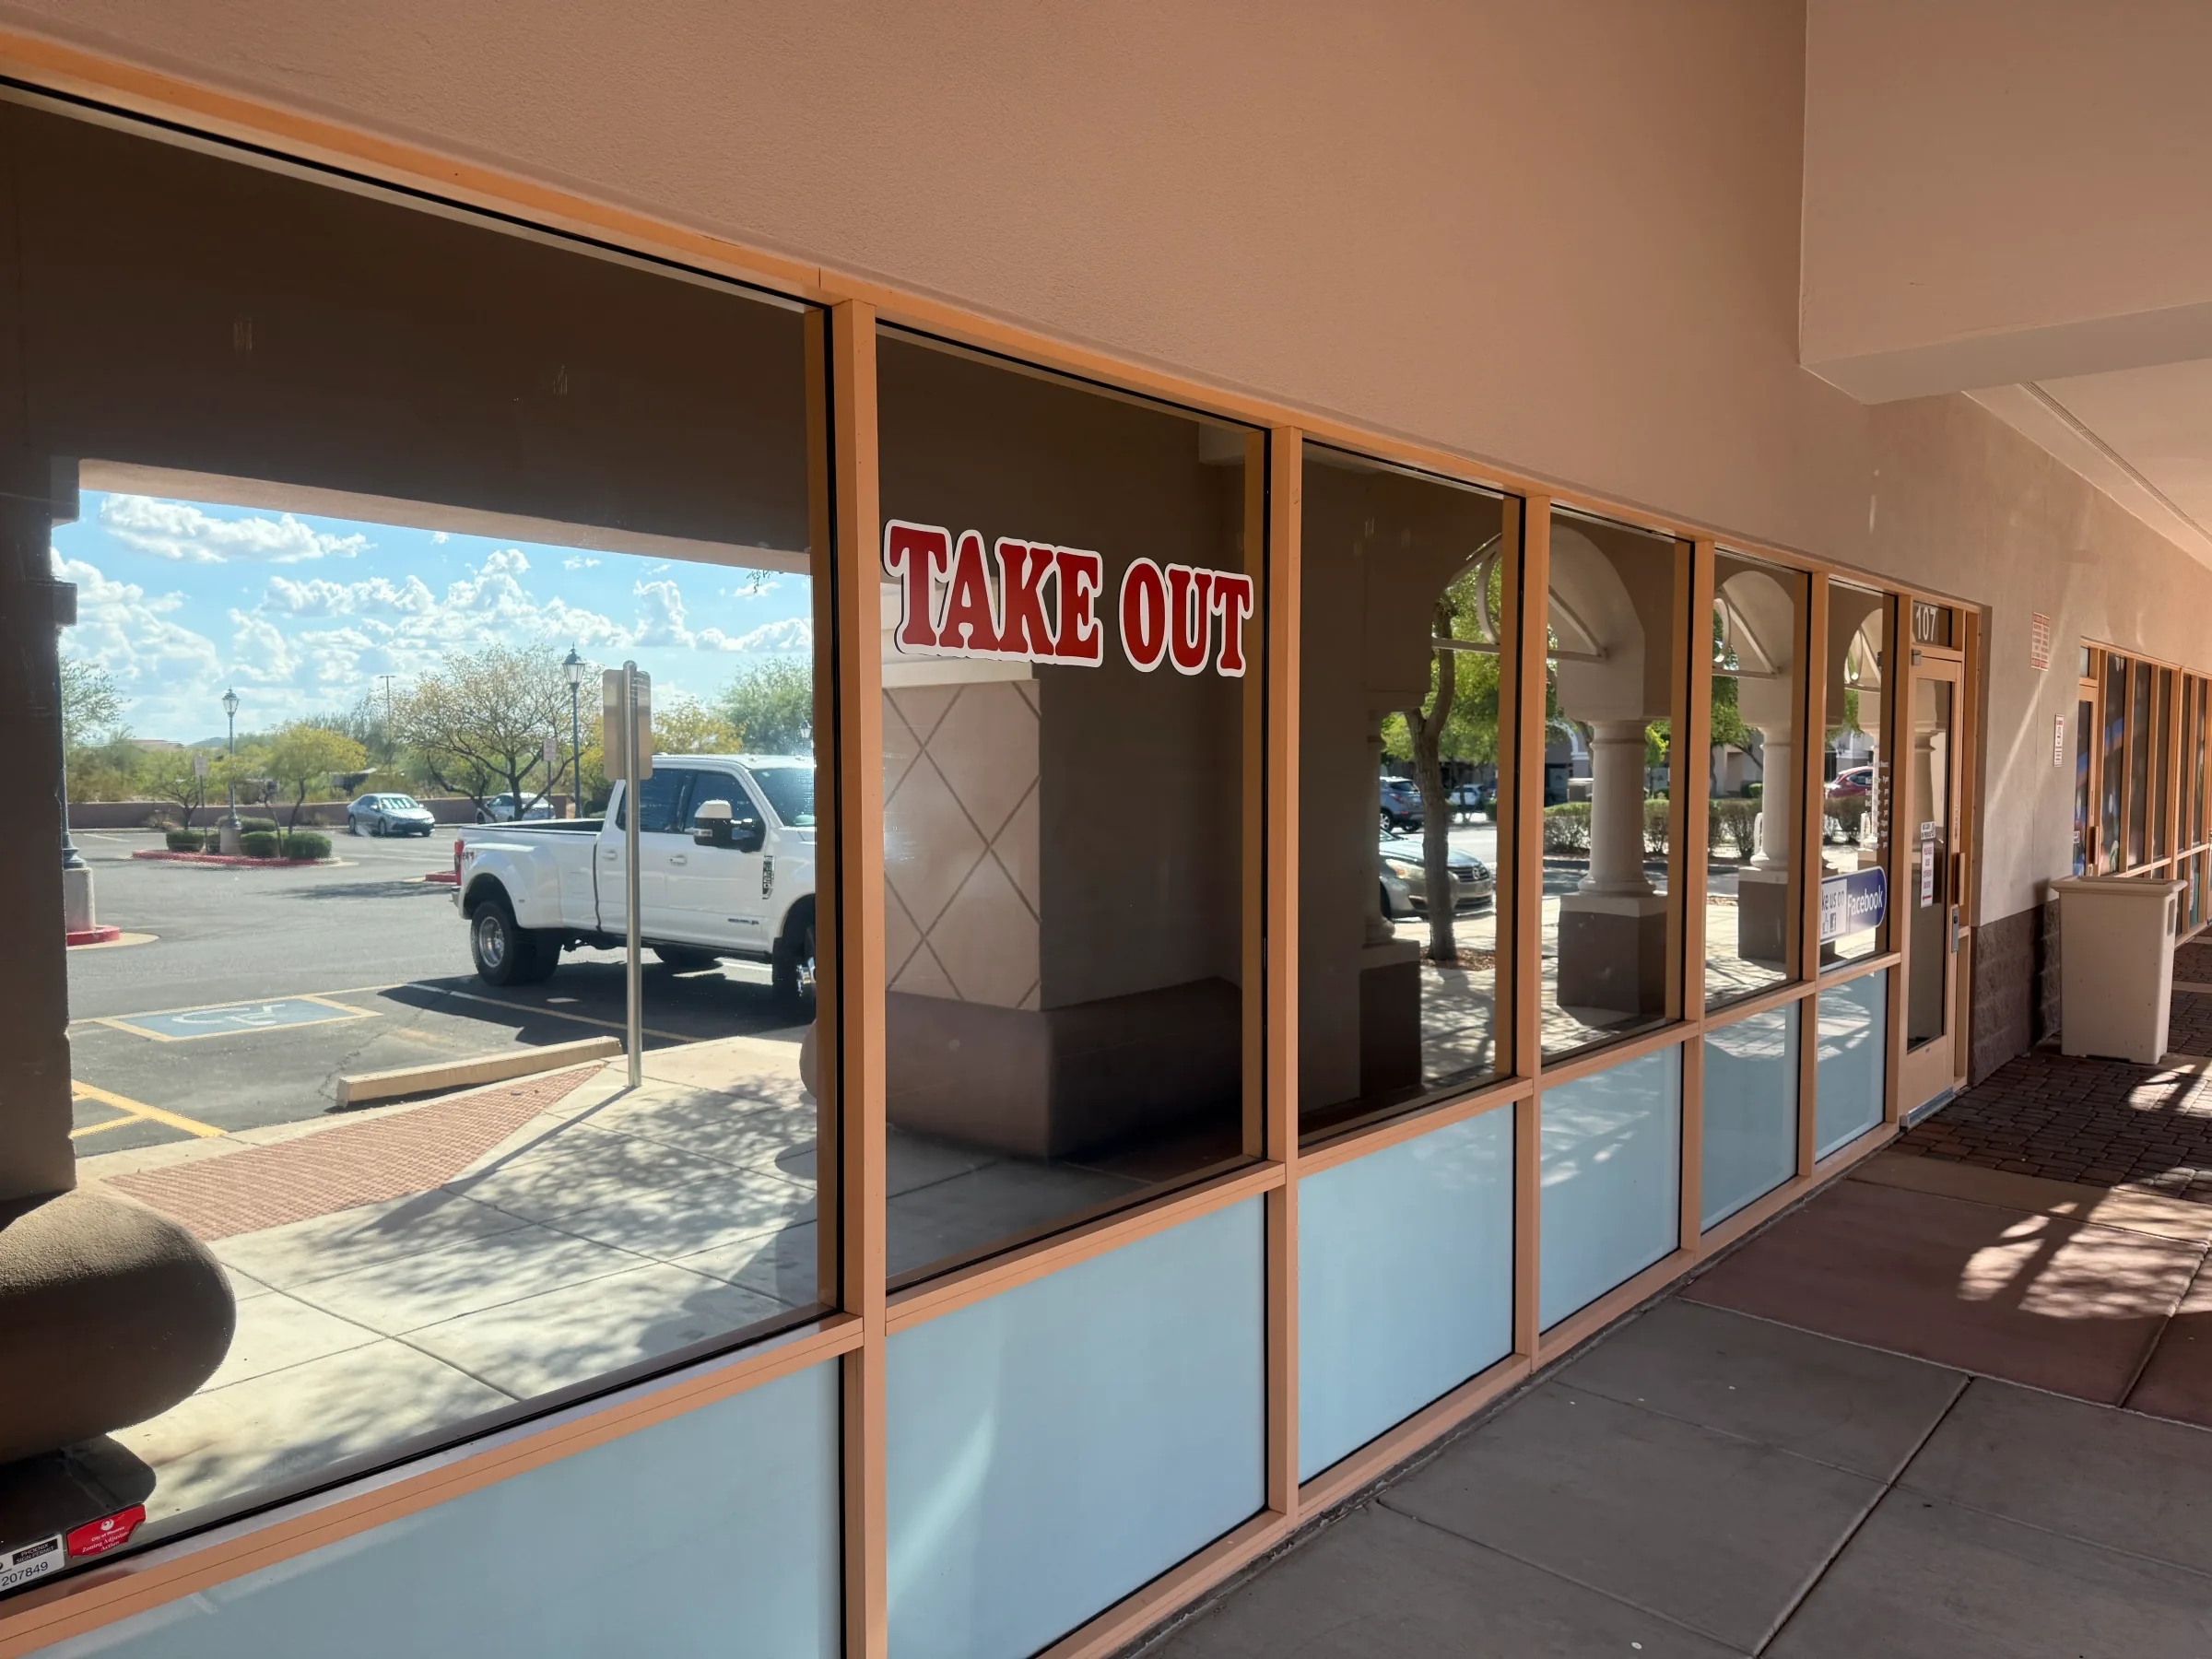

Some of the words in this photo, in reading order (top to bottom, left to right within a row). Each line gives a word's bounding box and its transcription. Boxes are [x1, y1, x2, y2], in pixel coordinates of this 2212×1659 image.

[884, 519, 1103, 667] TAKE
[1119, 558, 1253, 677] OUT
[1915, 606, 1936, 641] 107
[1830, 891, 1837, 909] us
[1838, 890, 1844, 908] on
[1847, 885, 1883, 918] Facebook
[16, 1553, 32, 1564] SIGN
[32, 1546, 54, 1559] PERMIT
[21, 1543, 49, 1557] PHOENIX
[82, 1542, 103, 1553] Zoning
[2, 1561, 48, 1586] 207849
